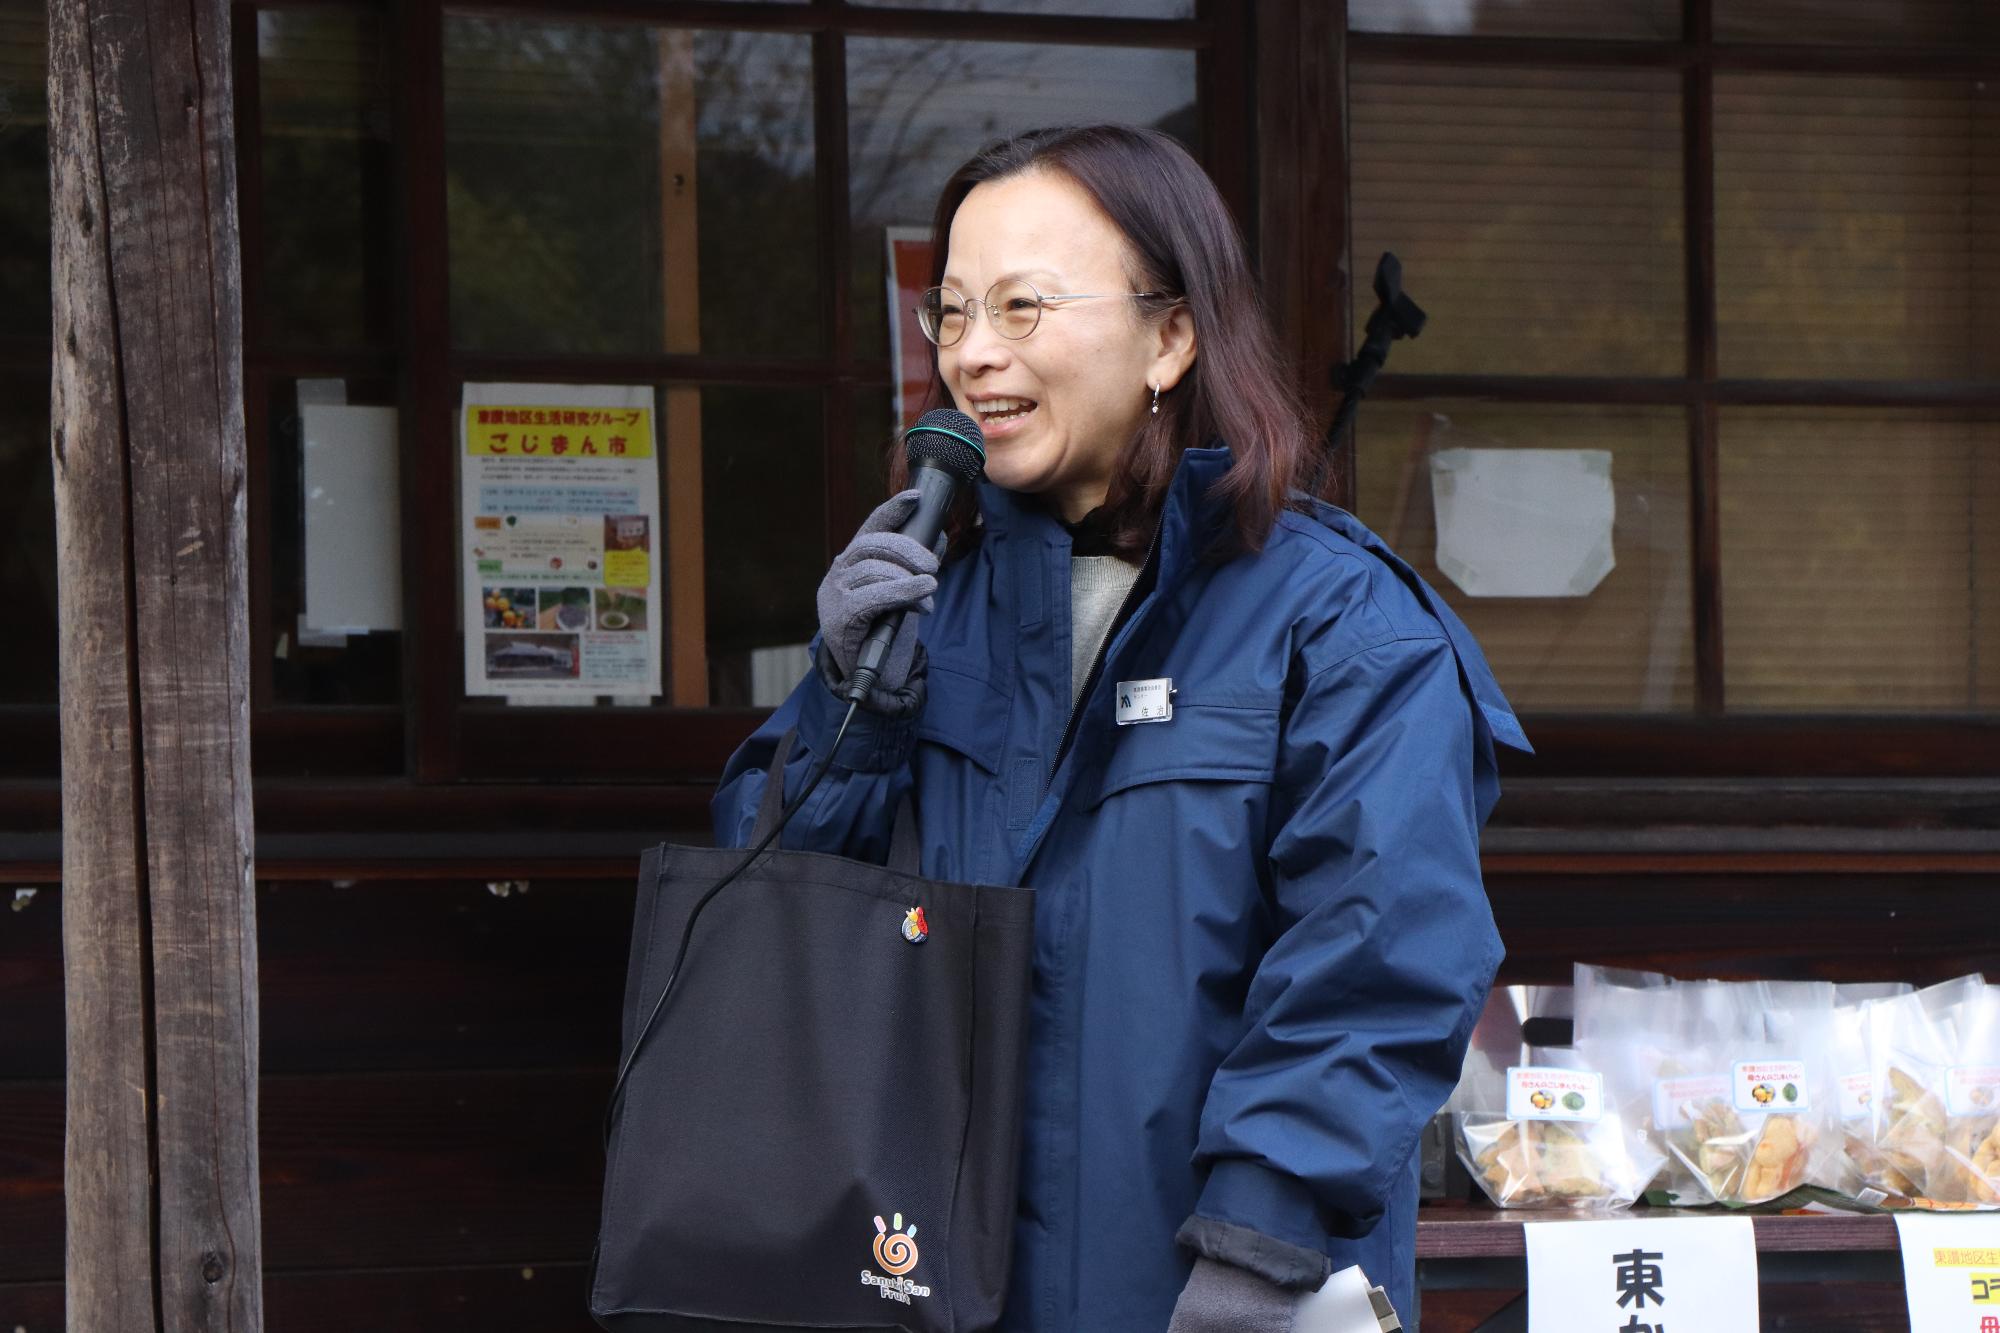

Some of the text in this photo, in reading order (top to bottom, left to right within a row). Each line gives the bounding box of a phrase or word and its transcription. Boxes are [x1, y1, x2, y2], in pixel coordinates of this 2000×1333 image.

[861, 1269, 931, 1297] Sanuki San
[880, 1286, 911, 1305] Fruit
